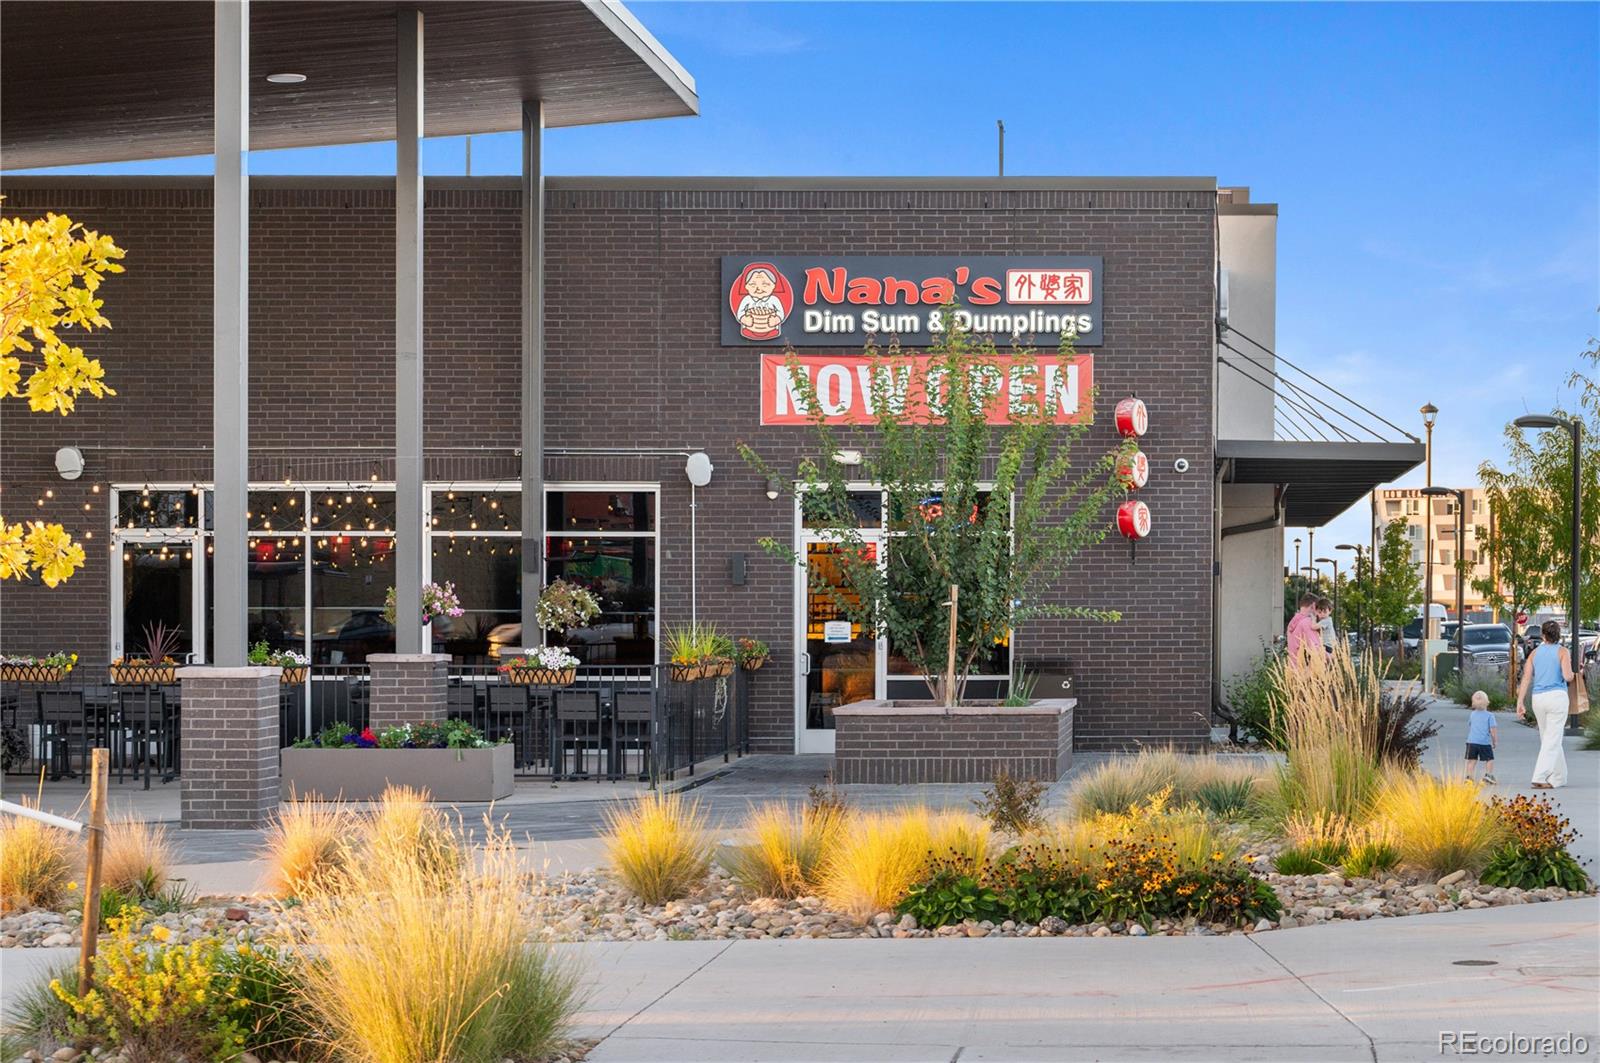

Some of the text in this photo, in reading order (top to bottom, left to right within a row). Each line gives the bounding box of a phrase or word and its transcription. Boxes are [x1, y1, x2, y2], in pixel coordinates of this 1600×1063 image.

[804, 267, 1002, 305] Nana's
[1015, 273, 1083, 300] 外婆家
[804, 309, 1093, 338] Dim Sum & Dumplings
[776, 364, 1079, 417] NOW OPEN
